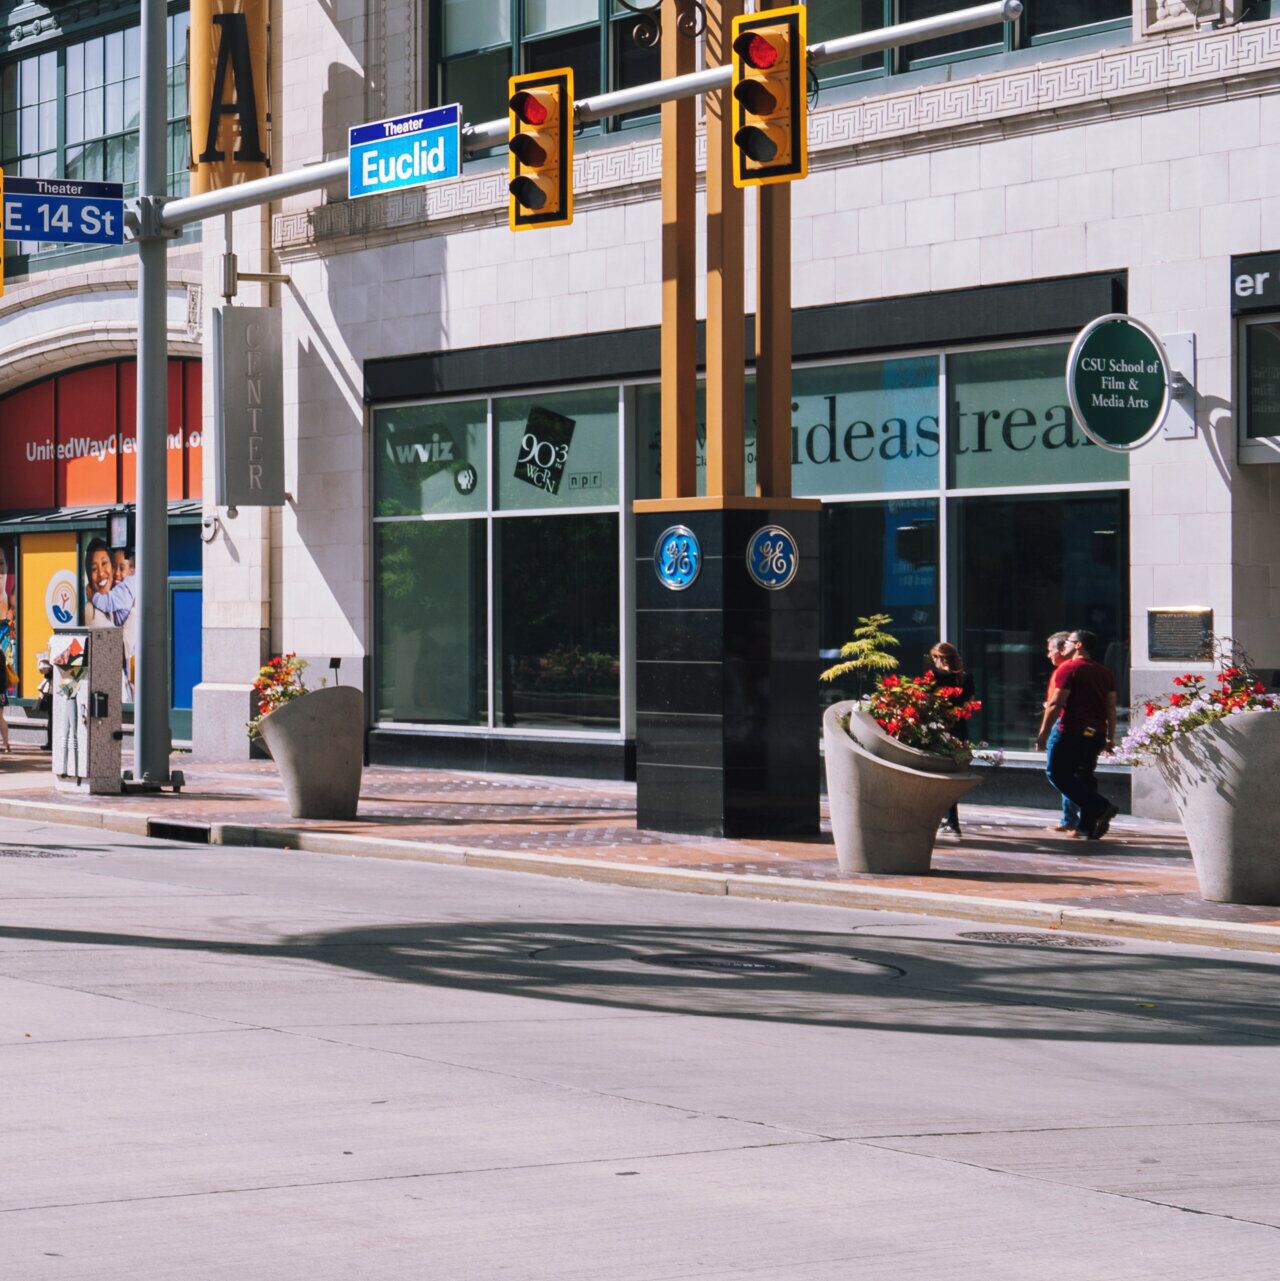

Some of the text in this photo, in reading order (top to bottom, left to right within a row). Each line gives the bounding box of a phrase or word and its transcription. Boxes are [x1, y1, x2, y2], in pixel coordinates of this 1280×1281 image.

[383, 118, 424, 136] Theater
[362, 136, 445, 187] Euclid
[36, 181, 83, 195] Theater
[5, 202, 115, 236] E. 14 St
[1081, 357, 1160, 374] CSU School of
[1101, 376, 1139, 391] Film &
[246, 322, 264, 490] CENTER
[1092, 394, 1149, 409] Media Arts
[395, 433, 454, 464] wviz
[526, 463, 555, 494] WCPN
[570, 473, 599, 487] npr
